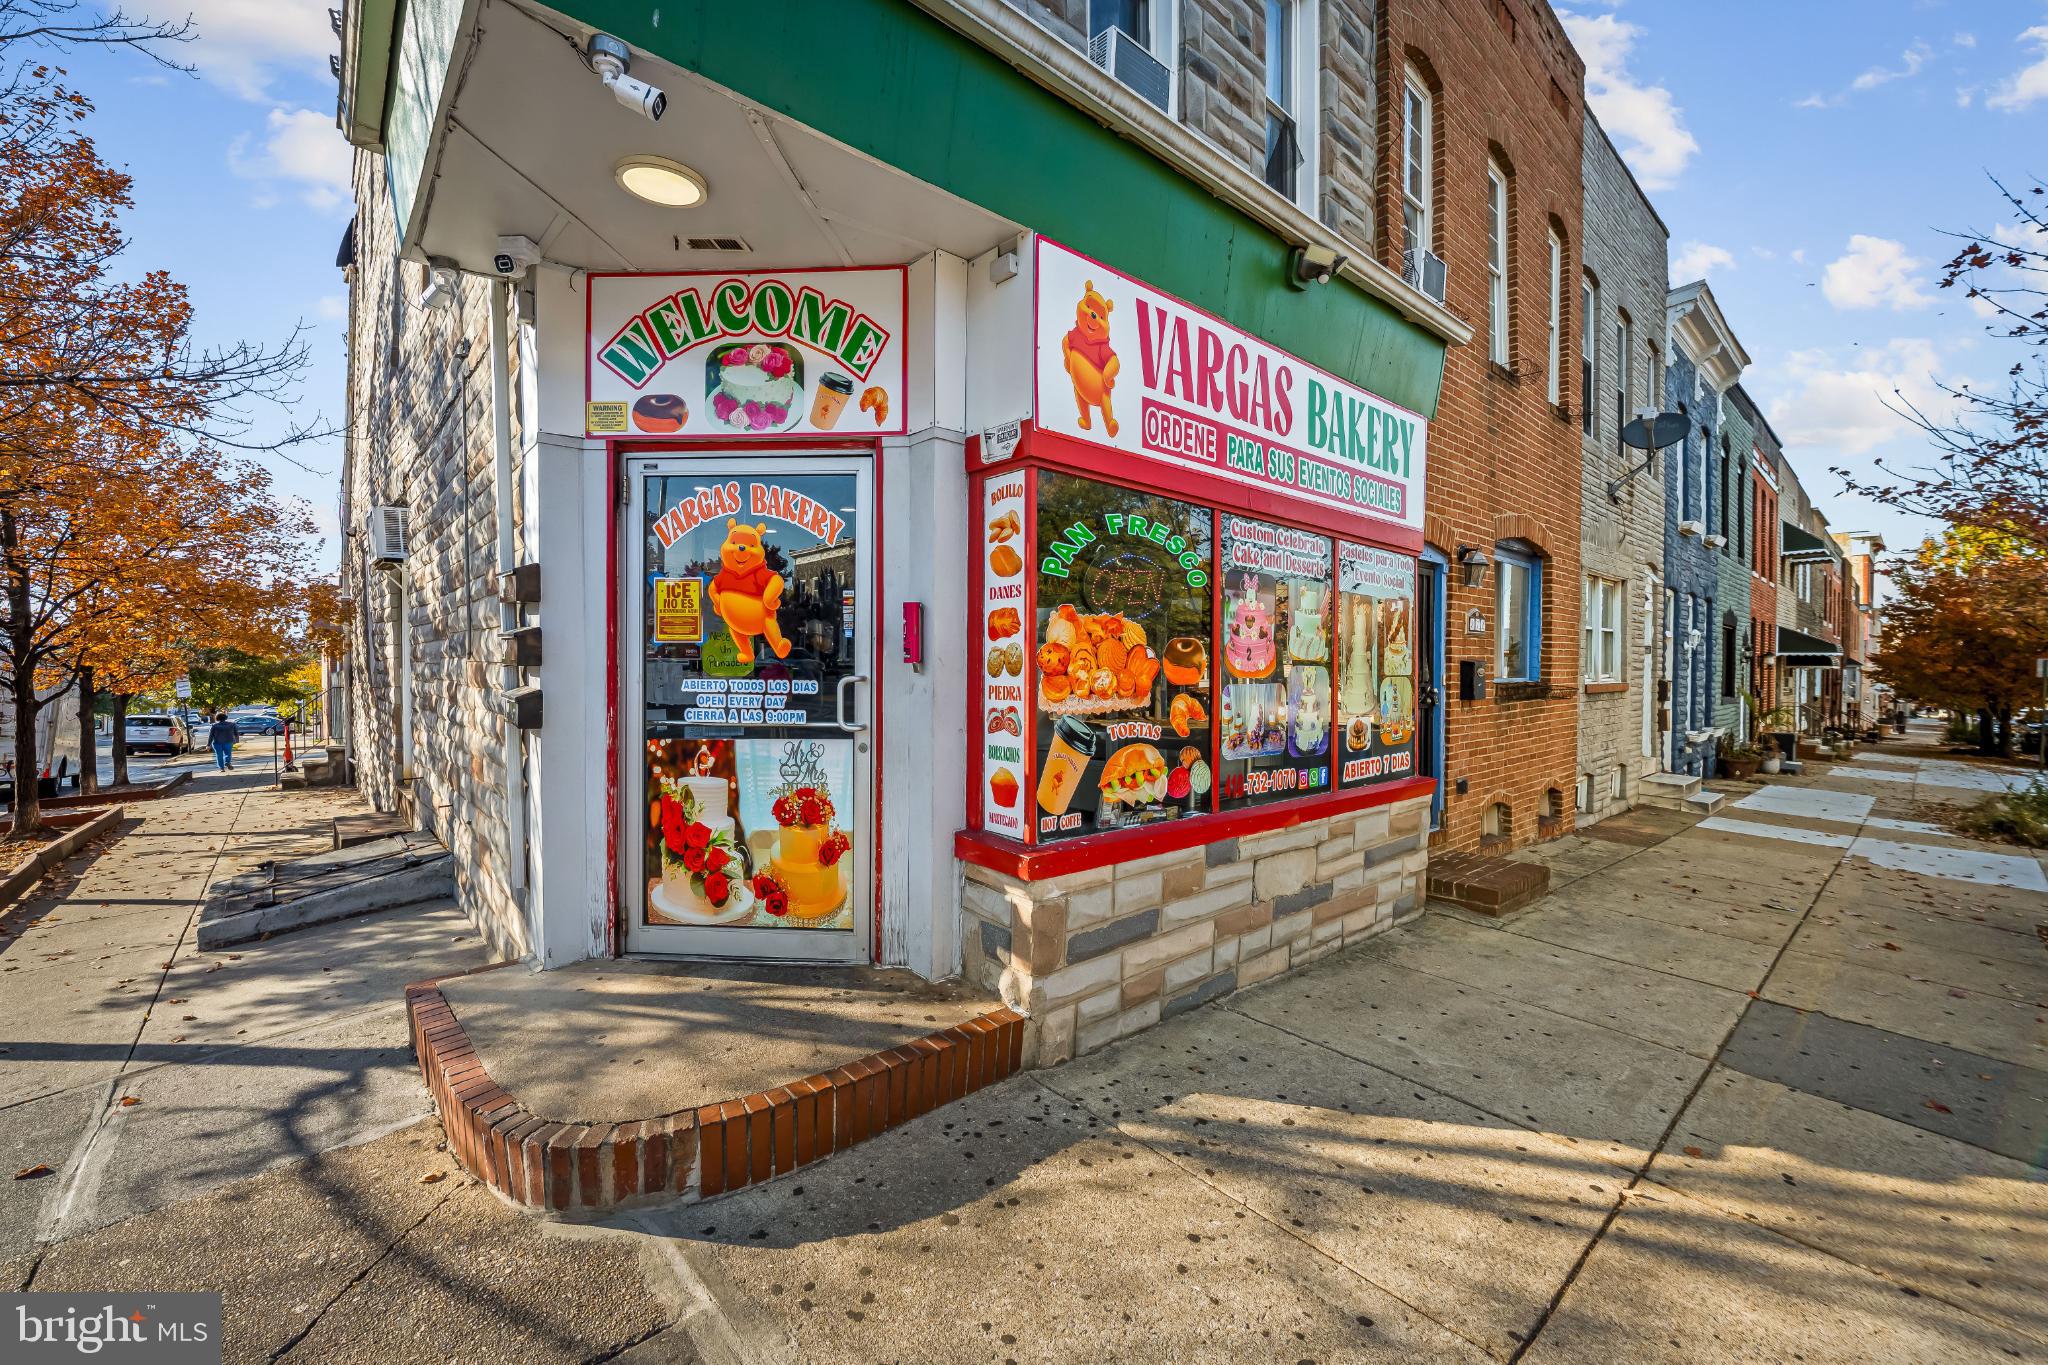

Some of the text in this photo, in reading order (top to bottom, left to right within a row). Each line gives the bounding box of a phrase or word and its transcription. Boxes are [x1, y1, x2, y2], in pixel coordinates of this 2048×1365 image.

[599, 281, 889, 388] WELCOME
[1136, 298, 1415, 479] VARGAS BAKERY
[593, 404, 623, 412] WARNING
[1145, 407, 1402, 514] ORDENE PARA SUS EVENTOS SOCIALES
[990, 484, 1023, 506] BOLILLO
[653, 481, 846, 549] VARGAS BAKERY
[1231, 518, 1326, 556] Custom Celebrate
[1042, 514, 1207, 587] PAN FRESCO
[1233, 542, 1326, 579] Cake and Desserts
[666, 582, 692, 598] ICE
[989, 584, 1022, 600] DANES
[664, 598, 695, 609] NO ES
[683, 680, 818, 694] ABIERTO TODOS LOS DIAS
[988, 685, 1022, 701] PIEDRA
[697, 694, 787, 708] OPEN EVERY DAY
[685, 708, 807, 724] CIERRA A LAS 9:00PM
[1107, 722, 1161, 740] TORTAS
[1343, 751, 1411, 782] ABIERTO 7 DIAS
[1041, 816, 1058, 832] HOT
